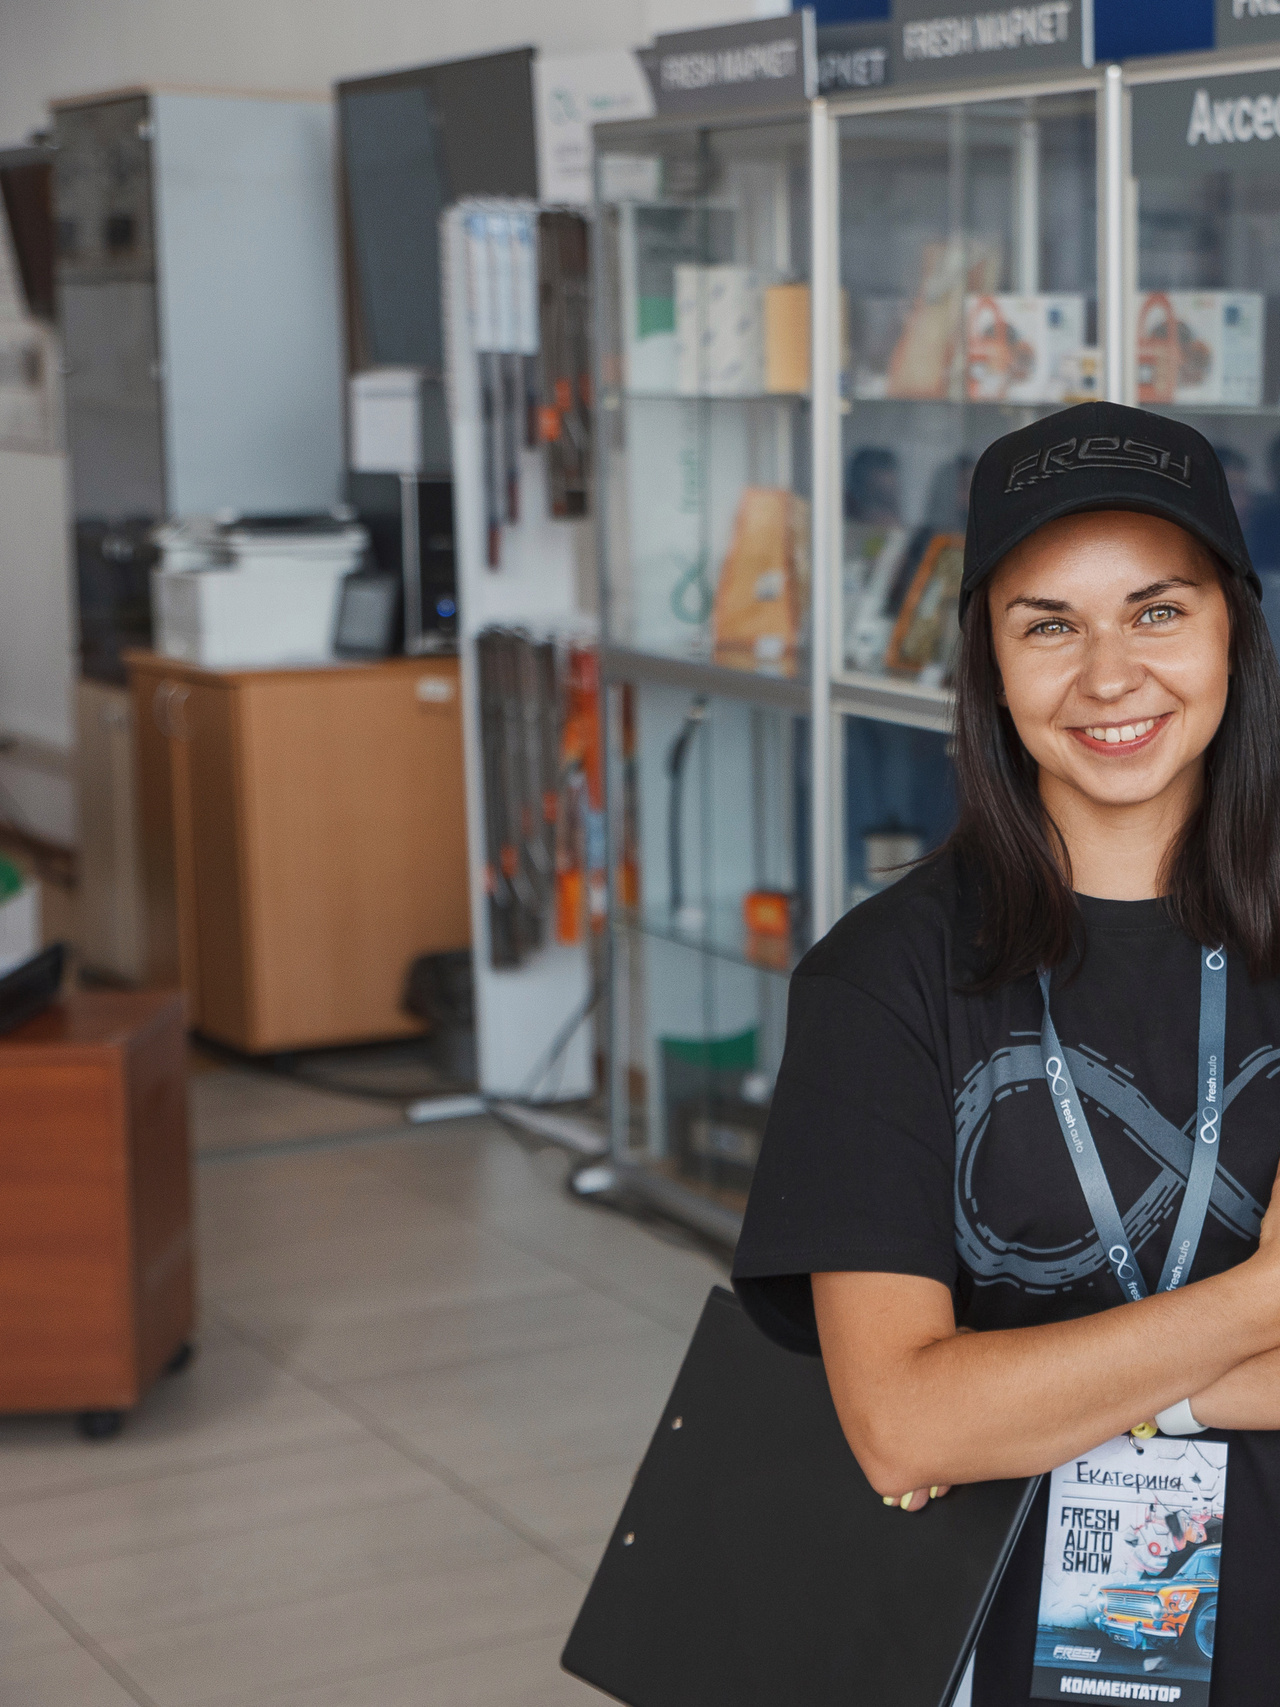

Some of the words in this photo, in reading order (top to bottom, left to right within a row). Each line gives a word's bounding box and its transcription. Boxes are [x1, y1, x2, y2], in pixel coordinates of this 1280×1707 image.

[903, 16, 972, 61] FRESH
[1208, 1055, 1217, 1075] auto
[1206, 1077, 1217, 1103] fresh
[1059, 1099, 1076, 1129] fresh
[1070, 1128, 1084, 1153] auto
[1166, 1265, 1183, 1291] fresh
[1177, 1240, 1191, 1265] auto
[1127, 1281, 1144, 1301] fres
[1060, 1506, 1120, 1532] FRESH
[1064, 1529, 1113, 1553] AUTO
[1062, 1550, 1112, 1575] SHOW
[1060, 1675, 1181, 1703] КОММЕНТАТОР
